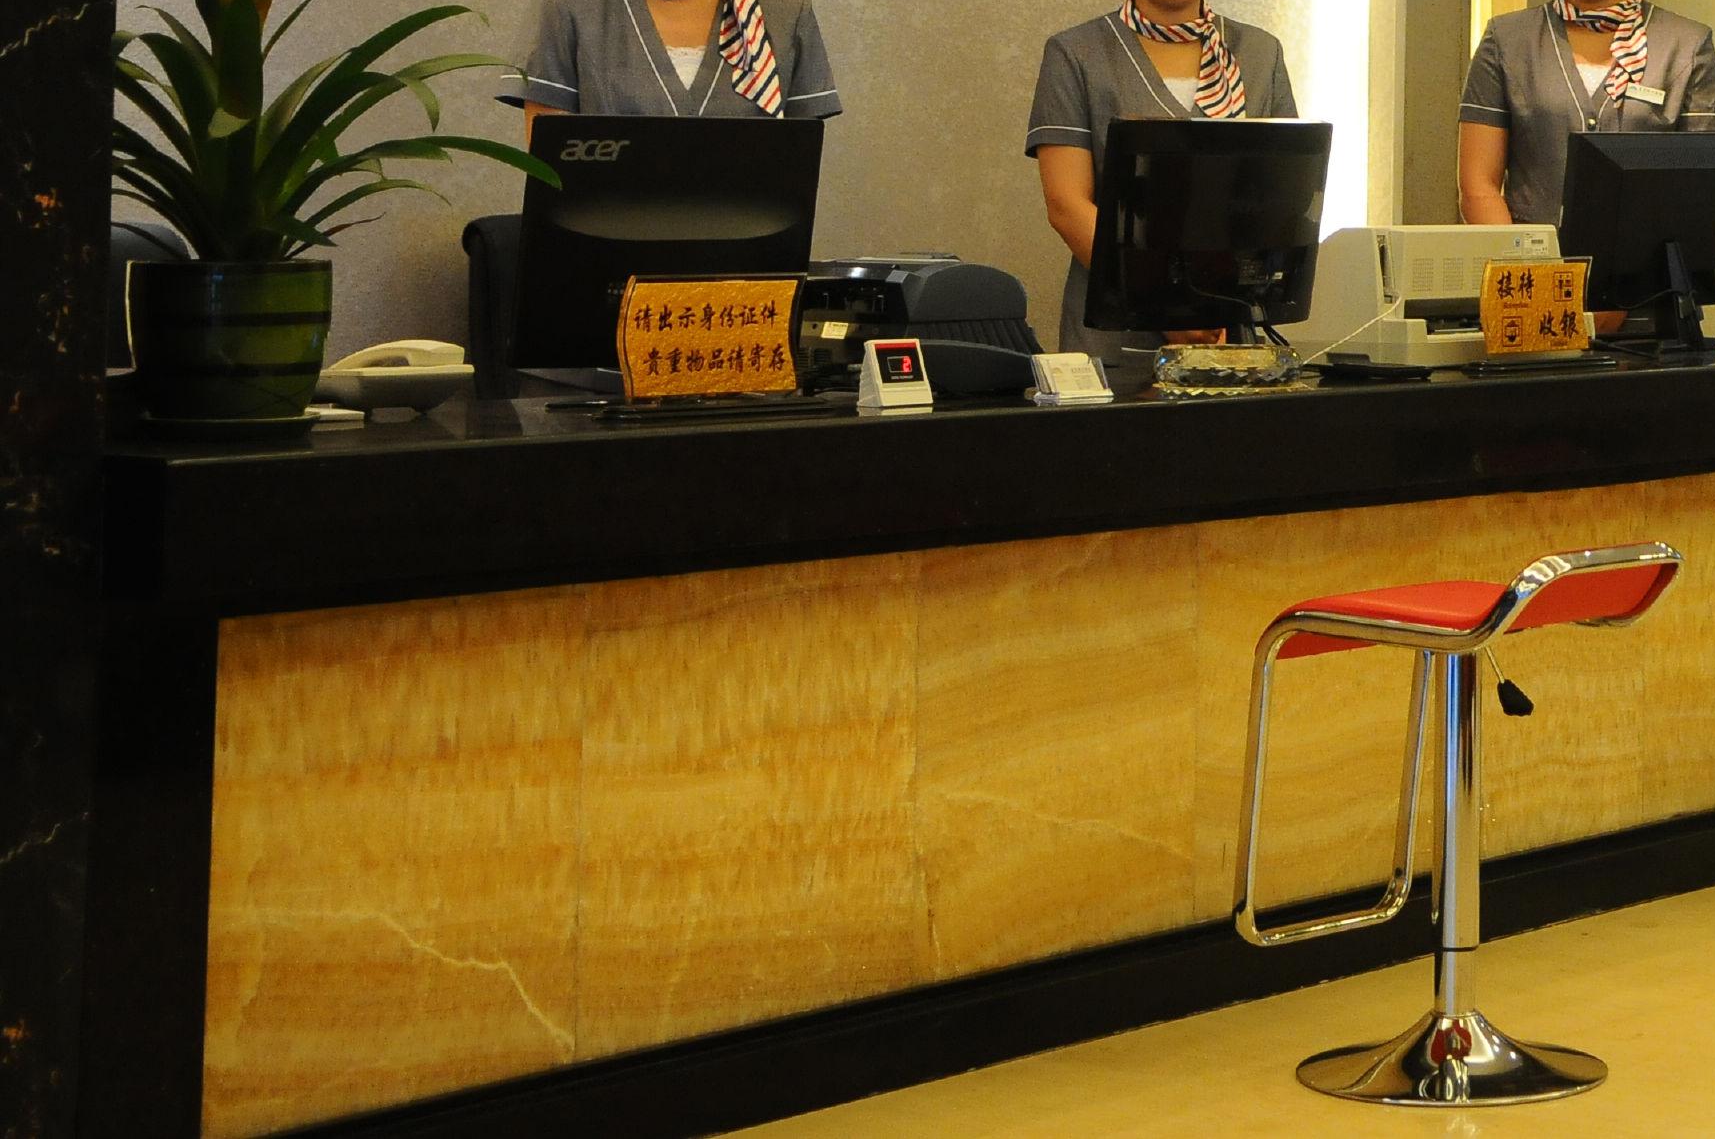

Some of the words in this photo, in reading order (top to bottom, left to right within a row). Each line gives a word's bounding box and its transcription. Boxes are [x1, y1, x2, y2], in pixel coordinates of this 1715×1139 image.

[560, 140, 630, 161] acer
[1497, 267, 1535, 300] 接待
[634, 299, 778, 332] 请出示身份证件
[1539, 308, 1579, 339] 收银
[643, 342, 786, 376] 贵重物品请寄存
